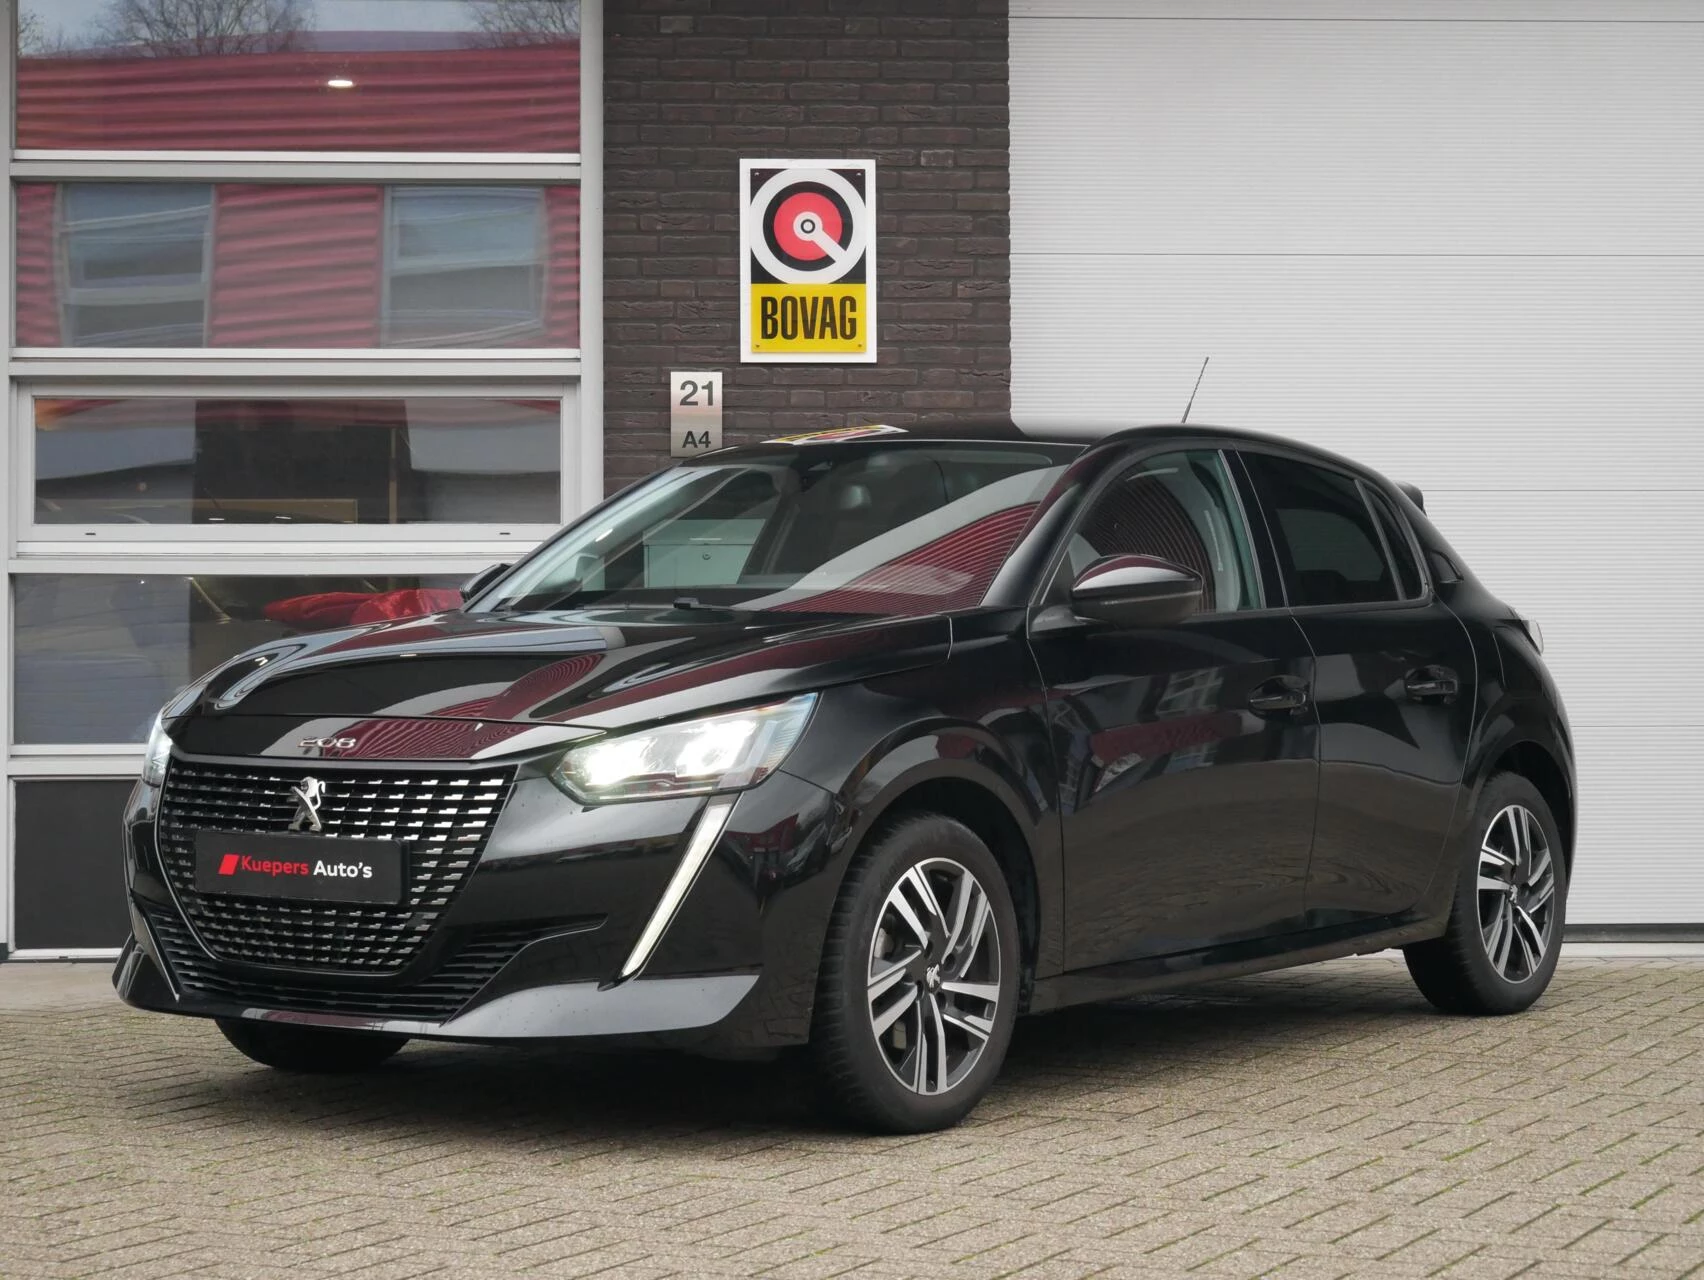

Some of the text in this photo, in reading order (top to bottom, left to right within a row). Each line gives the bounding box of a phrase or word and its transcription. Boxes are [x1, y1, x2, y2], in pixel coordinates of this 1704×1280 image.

[760, 296, 857, 340] BOVAG
[679, 380, 714, 406] 21
[682, 431, 711, 448] A4
[298, 736, 356, 749] 208
[241, 855, 373, 879] Kuepers Auto's
